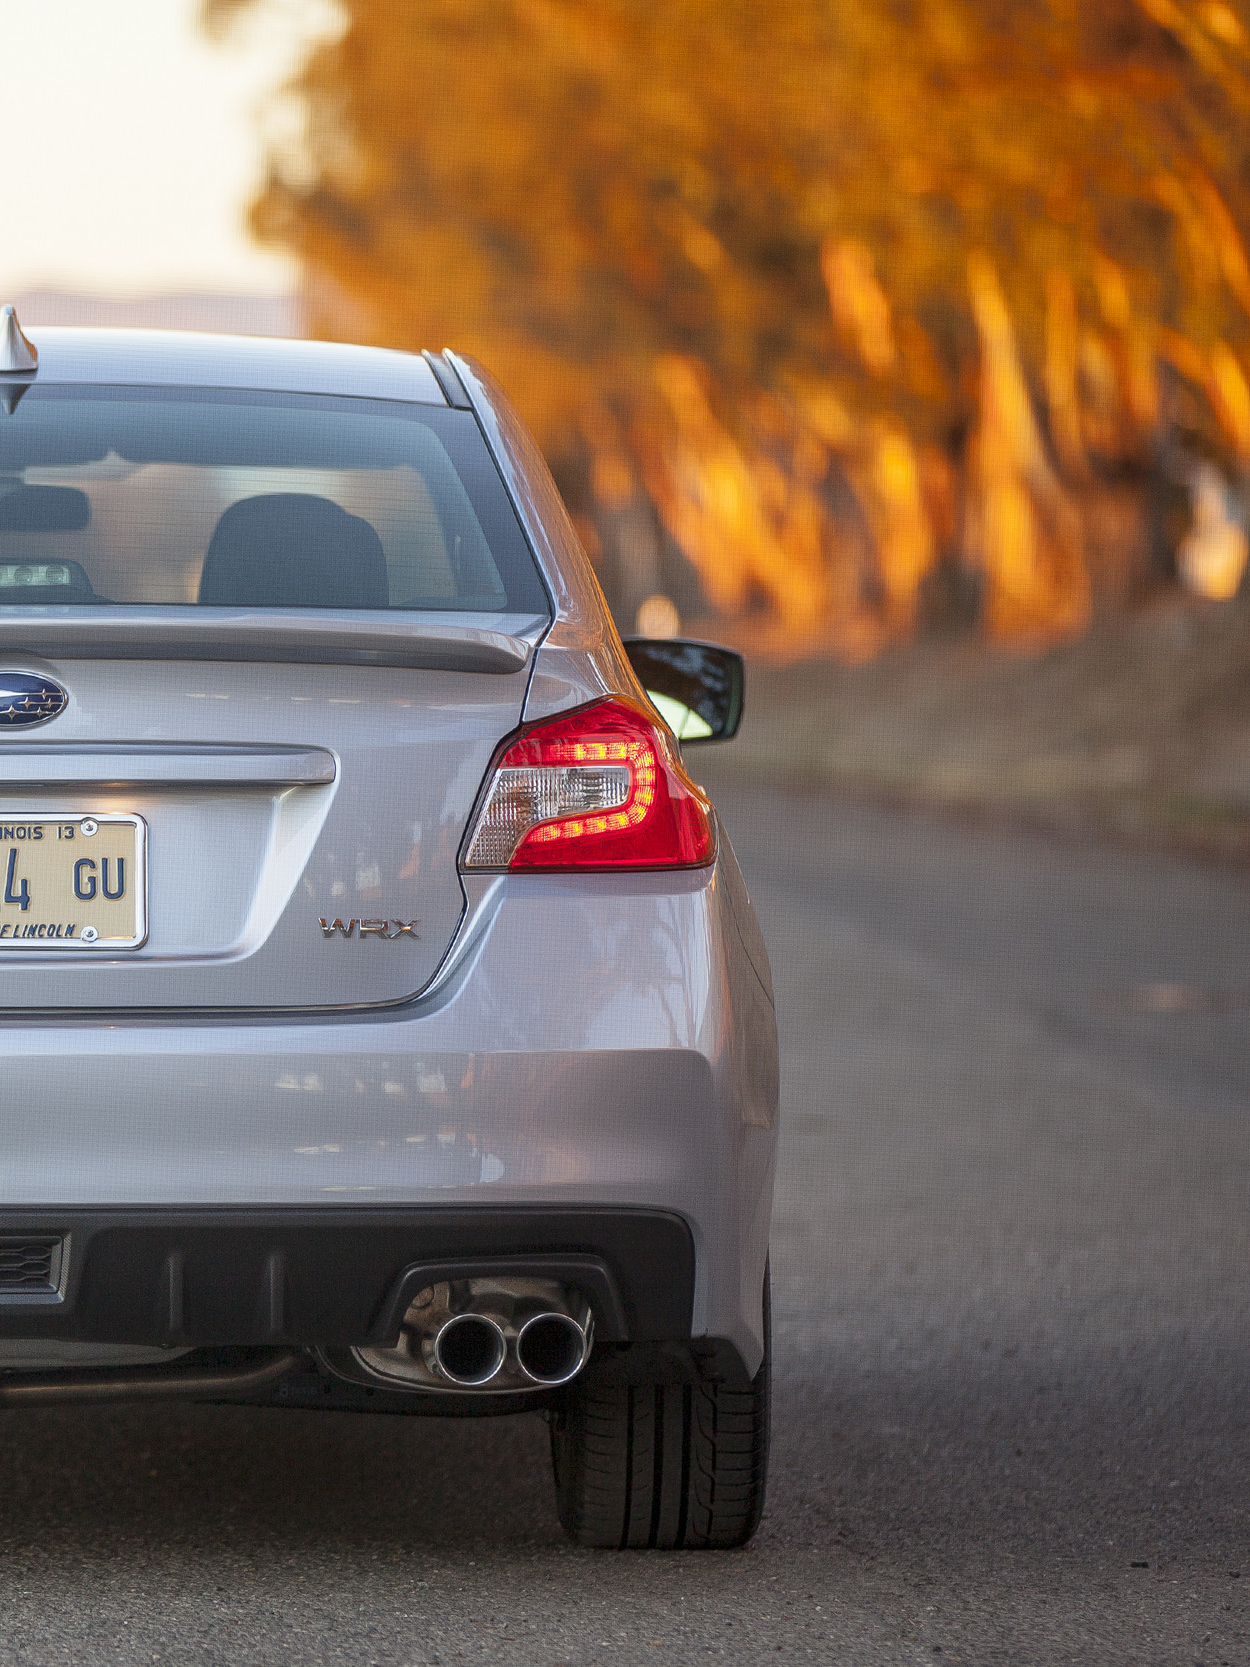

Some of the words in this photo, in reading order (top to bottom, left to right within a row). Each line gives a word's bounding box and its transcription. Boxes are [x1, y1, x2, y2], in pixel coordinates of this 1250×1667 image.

[57, 826, 75, 840] 13
[73, 857, 125, 900] GU
[12, 924, 76, 938] LINCOLN
[317, 917, 421, 940] WRX
